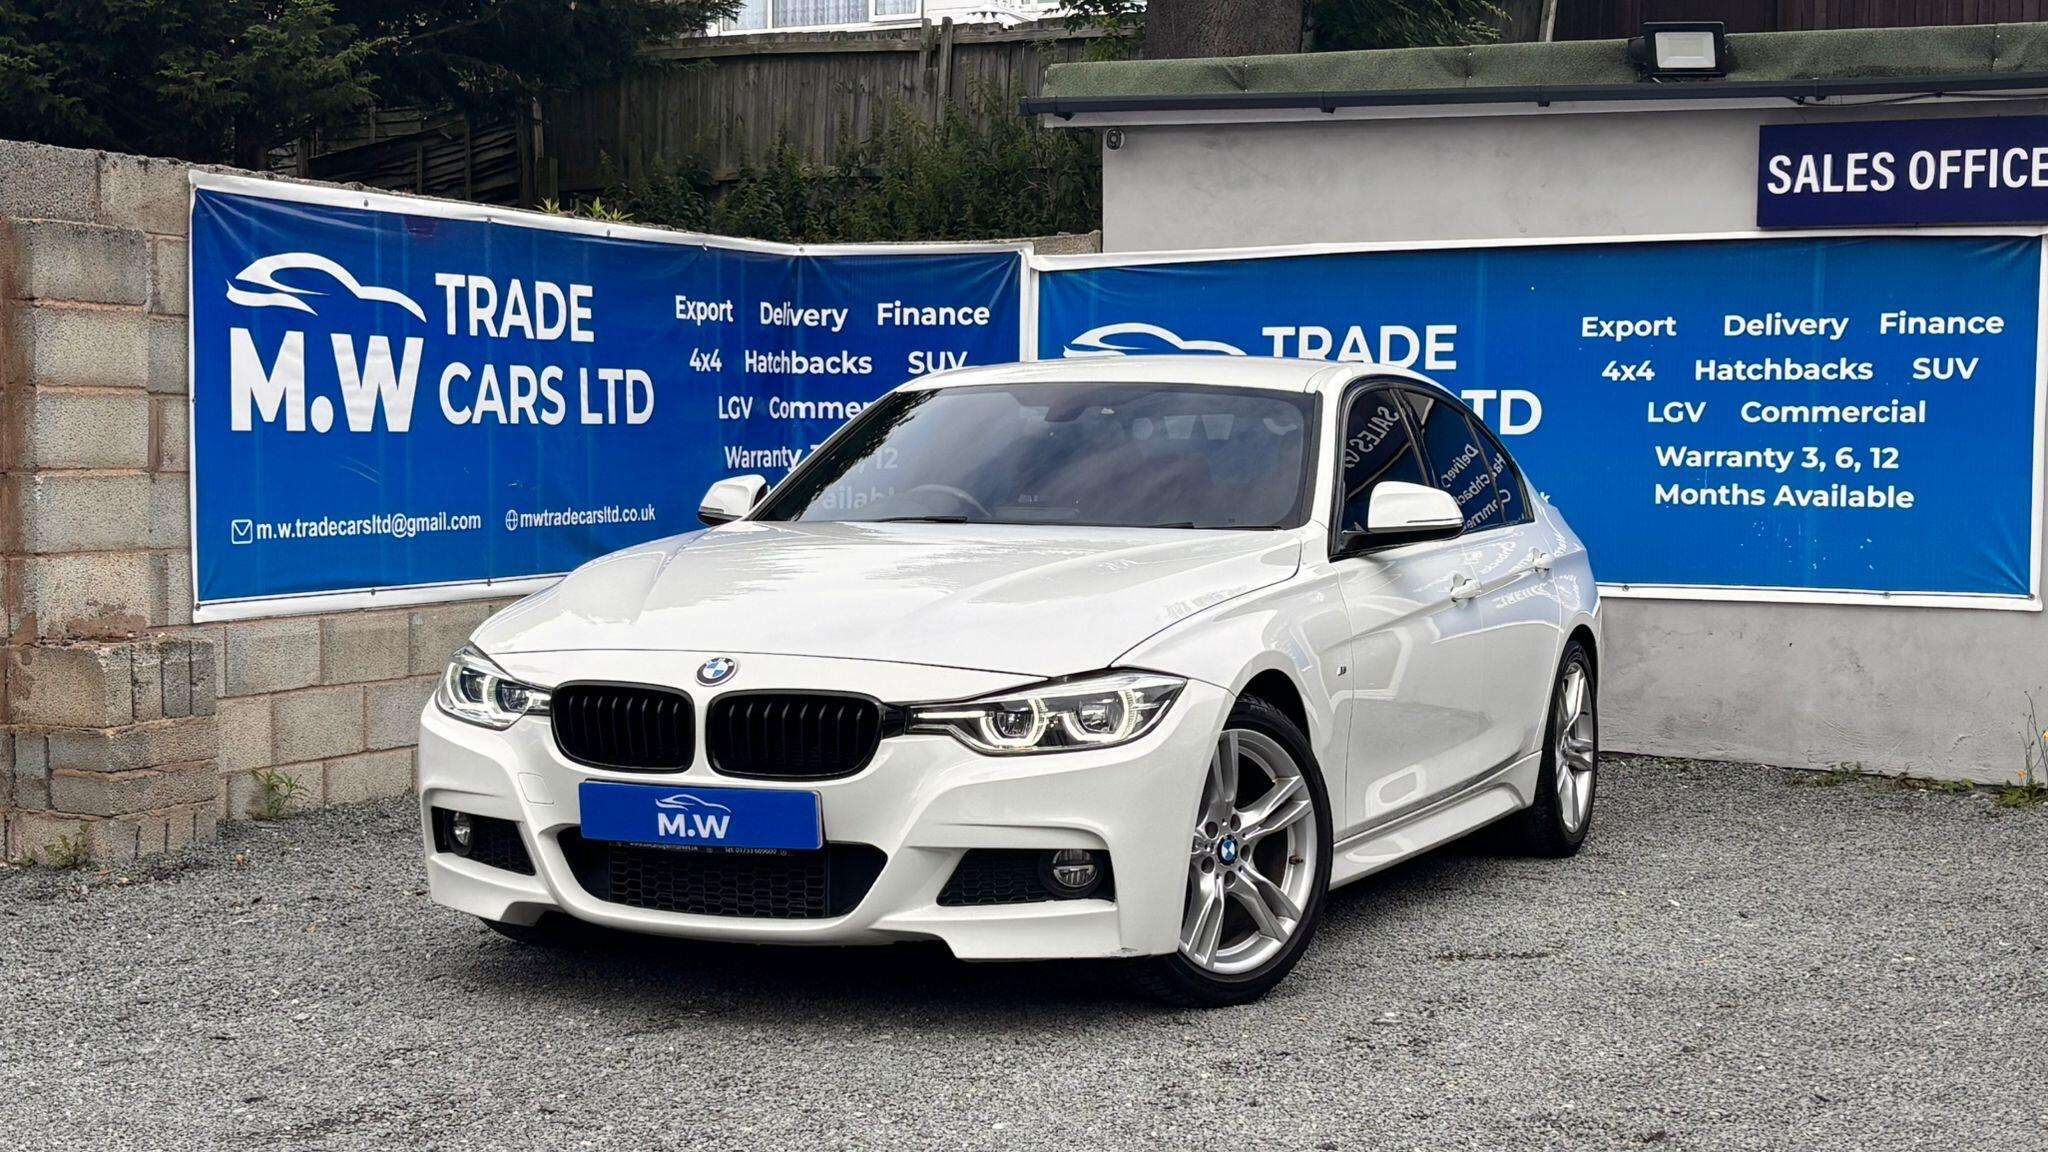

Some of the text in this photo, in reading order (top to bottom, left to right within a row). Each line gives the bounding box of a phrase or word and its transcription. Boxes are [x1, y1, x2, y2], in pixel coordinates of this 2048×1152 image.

[1767, 146, 2048, 195] SALES OFFICE
[435, 272, 595, 343] TRADE
[675, 295, 990, 332] Export Delivery Finance
[1581, 310, 2005, 342] Export Delivery Finance
[689, 348, 968, 375] 4x4 Hatchbacks SUV
[1601, 357, 1979, 381] 4x4 Hatchbacks SUV
[230, 327, 424, 434] M.W
[439, 361, 655, 426] CARS LTD
[718, 395, 754, 420] LGV
[1461, 390, 1542, 435] TD
[1647, 398, 1926, 423] LGV Commercial
[724, 445, 803, 472] Warranty
[1654, 446, 1900, 474] Warranty 3, 6, 12
[1655, 483, 1915, 509] Months Available
[257, 512, 481, 540] m.w.tradecarsltd@gmail.com
[520, 503, 656, 528] mwtradecarsltd.co.uk
[657, 812, 731, 840] M.W
